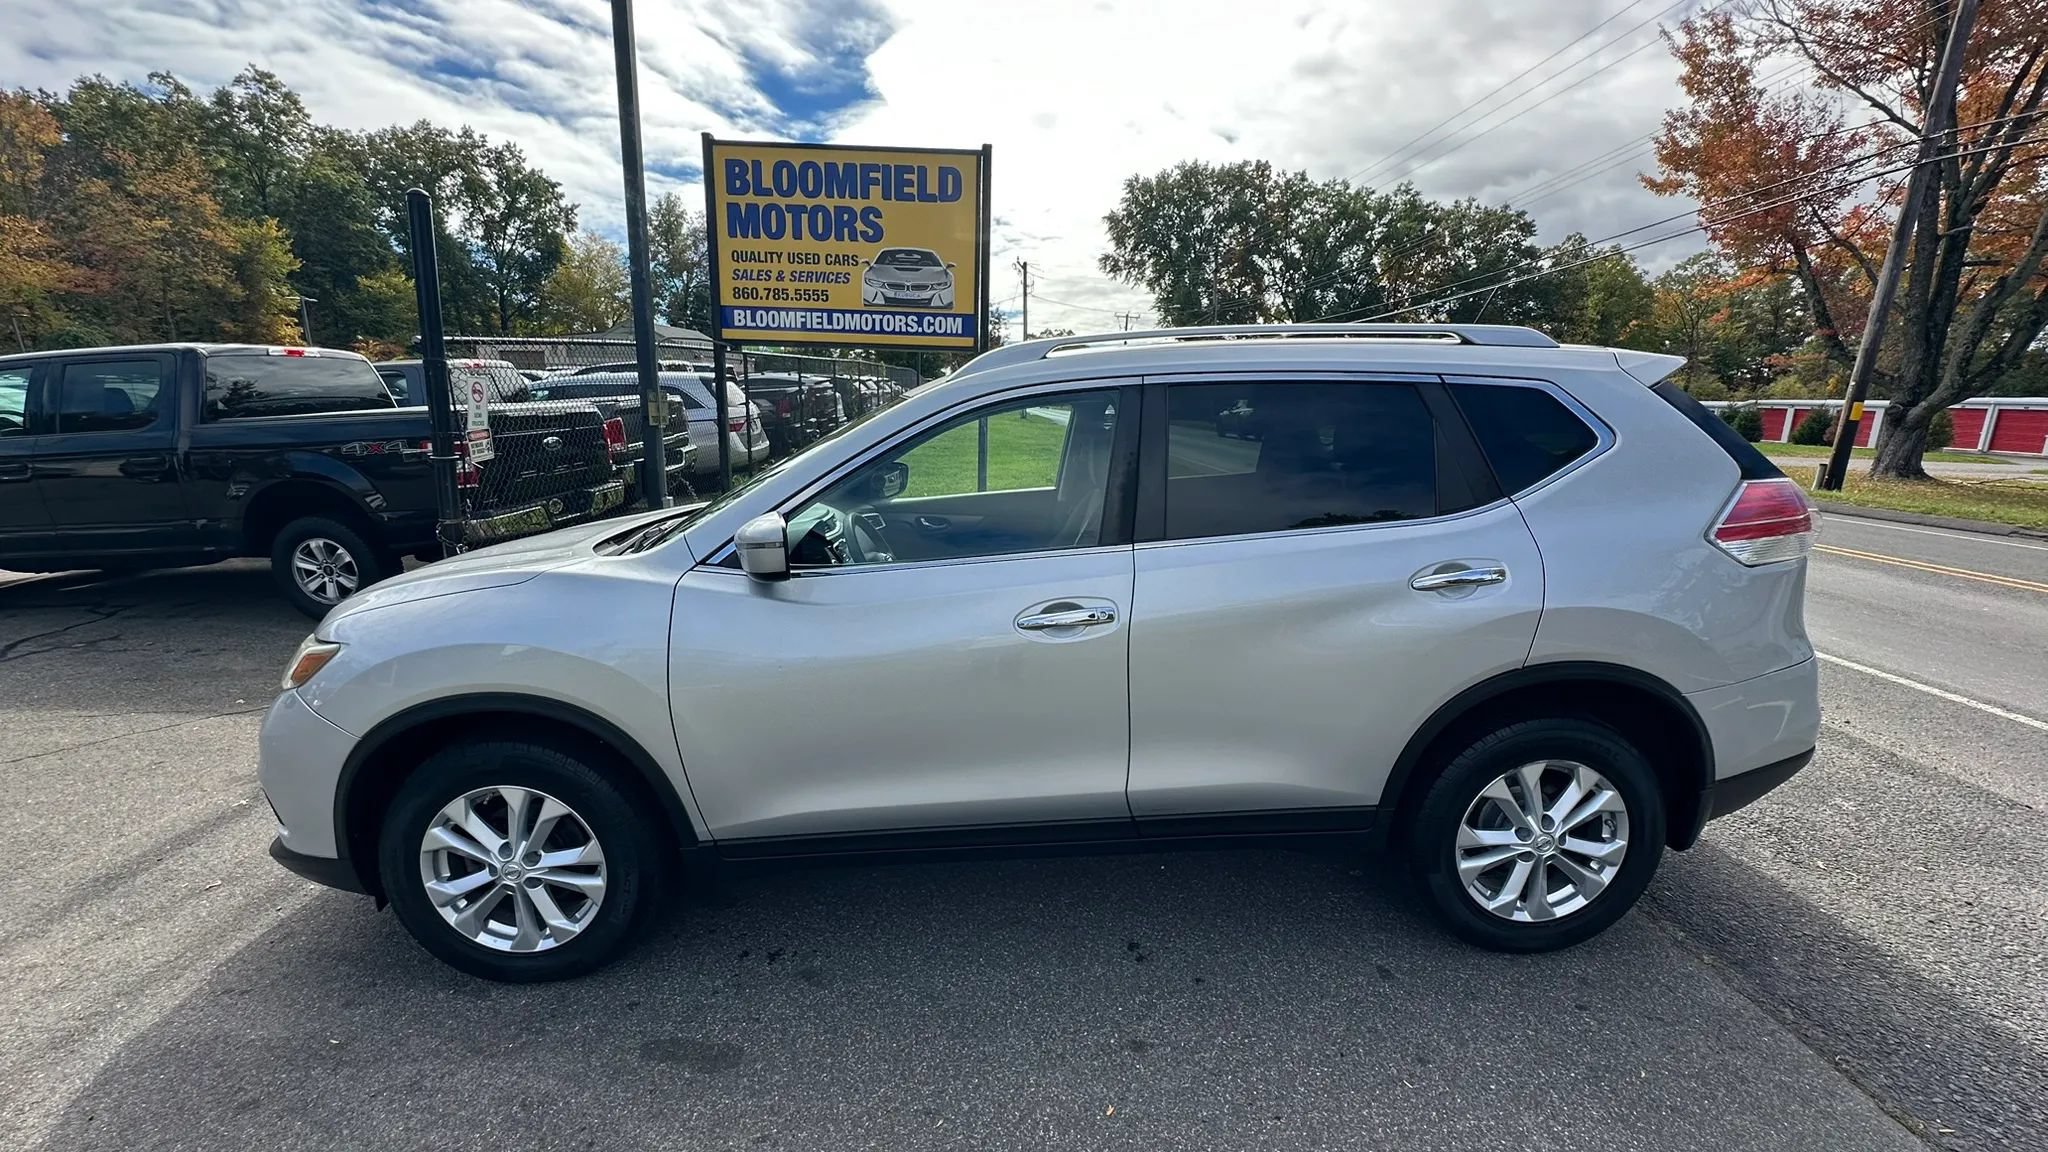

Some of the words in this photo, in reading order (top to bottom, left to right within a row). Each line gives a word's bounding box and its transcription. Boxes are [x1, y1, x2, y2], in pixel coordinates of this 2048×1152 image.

[724, 158, 963, 203] BLOOMFIELD
[726, 202, 885, 244] MOTORS
[731, 250, 783, 264] QUALITY
[787, 252, 820, 265] USED
[825, 253, 859, 267] CARS
[732, 268, 772, 281] SALES
[775, 270, 785, 282] &
[789, 270, 851, 285] SERVICES
[732, 286, 829, 302] 860.785.5555
[733, 309, 963, 334] BLOOMFIELDMOTORS.COM
